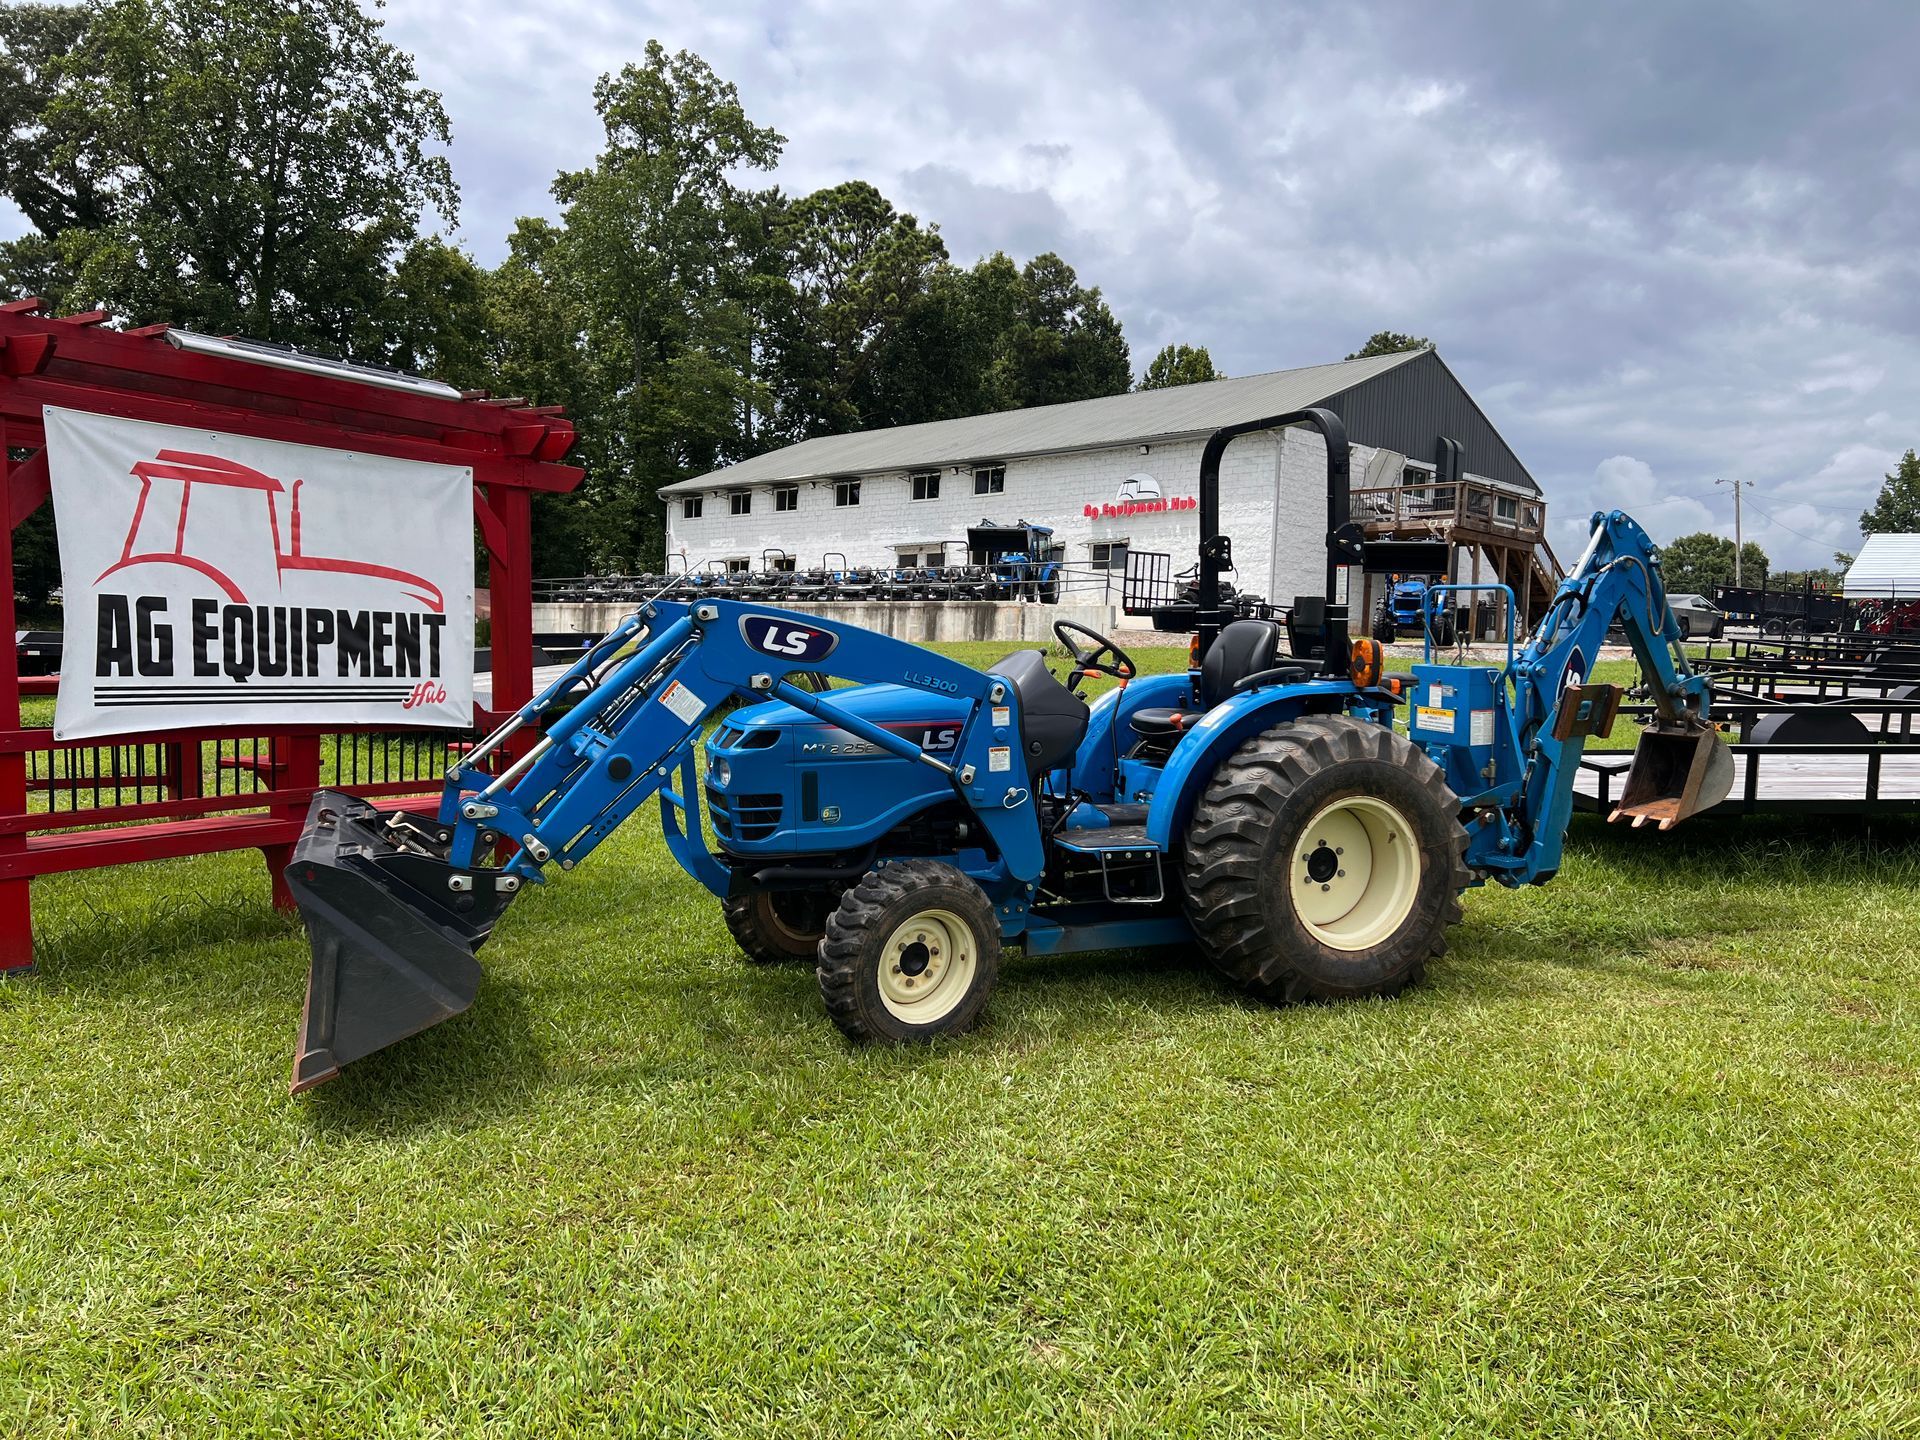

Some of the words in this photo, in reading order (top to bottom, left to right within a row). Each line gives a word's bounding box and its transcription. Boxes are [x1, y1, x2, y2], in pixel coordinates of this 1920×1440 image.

[1083, 504, 1099, 520] Ag
[1102, 498, 1168, 518] Equipment
[1170, 496, 1197, 511] Hub
[95, 594, 175, 677] AG
[192, 599, 447, 683] EQUIPMENT
[762, 626, 810, 655] LS
[903, 671, 958, 692] LL3300
[402, 681, 447, 710] Hub
[922, 730, 955, 750] LS
